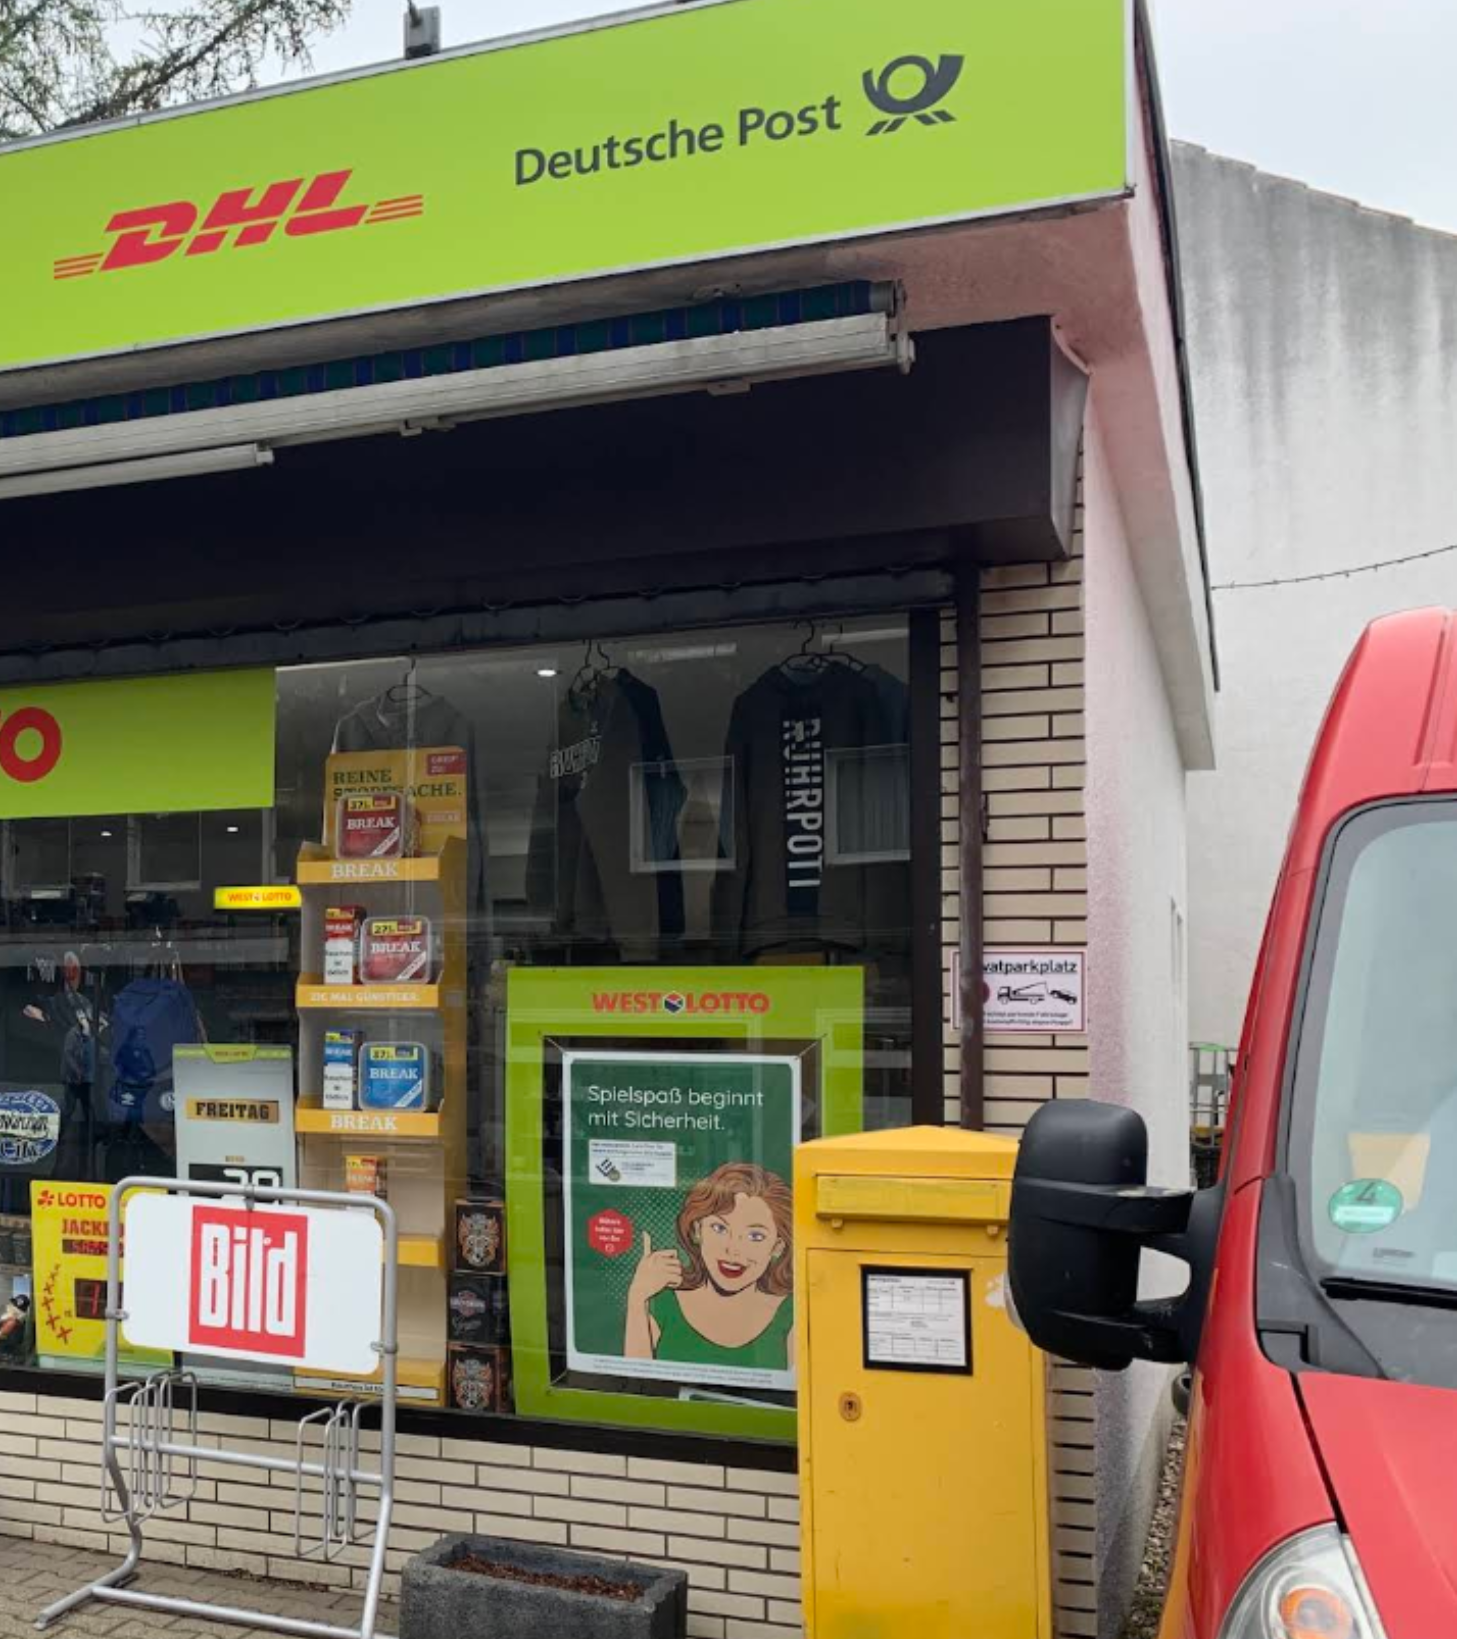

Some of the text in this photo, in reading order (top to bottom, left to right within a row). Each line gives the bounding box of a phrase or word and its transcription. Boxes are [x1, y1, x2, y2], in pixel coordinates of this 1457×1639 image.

[514, 94, 842, 186] Deutsche Post
[99, 169, 370, 271] DHL
[332, 769, 392, 785] REINE
[346, 816, 395, 830] BREAK
[331, 862, 398, 878] BREAK
[262, 891, 292, 902] LOTTO
[370, 941, 421, 954] BREAK
[983, 959, 1077, 975] vatparkplatz
[592, 992, 771, 1014] WEST LOTTO
[369, 1067, 418, 1080] BREAK
[588, 1084, 763, 1109] Spielspaß beginnt
[195, 1101, 270, 1121] FREITAG
[330, 1114, 398, 1131] BREAK
[588, 1110, 726, 1131] mit Sicherheit.
[57, 1193, 106, 1210] LOTTO
[198, 1221, 298, 1339] Bild
